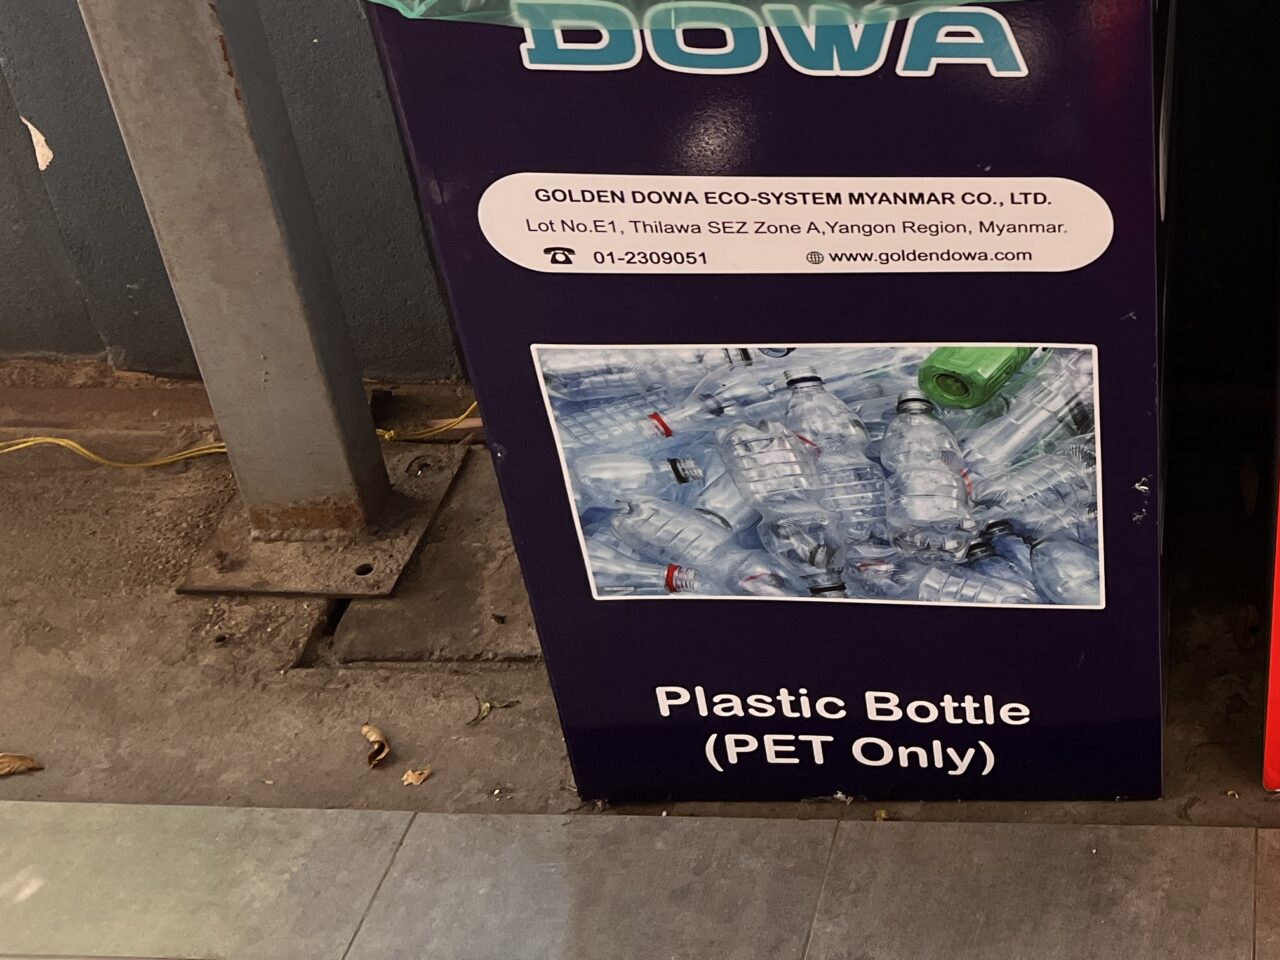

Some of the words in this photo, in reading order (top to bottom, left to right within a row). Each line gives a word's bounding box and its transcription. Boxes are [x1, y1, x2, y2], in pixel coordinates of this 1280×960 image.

[535, 188, 625, 204] GOLDEN
[632, 190, 699, 205] DOWA
[704, 191, 842, 205] ECO-SYSTEM
[848, 192, 955, 205] MYANMAR
[961, 192, 1004, 207] CO.,
[1010, 192, 1052, 205] LTD.
[526, 219, 555, 233] Lot
[628, 220, 702, 234] Thilawa
[708, 221, 749, 234] SEZ
[753, 221, 801, 234] Zone
[902, 220, 972, 237] Region,
[978, 220, 1068, 237] Myanmar.
[593, 251, 708, 265] 01-2309051
[829, 249, 1033, 265] www.goldendowa.com
[655, 685, 846, 719] Plastic
[864, 690, 1031, 726] Bottle
[705, 733, 834, 771] (PET
[852, 737, 995, 775] Only)
